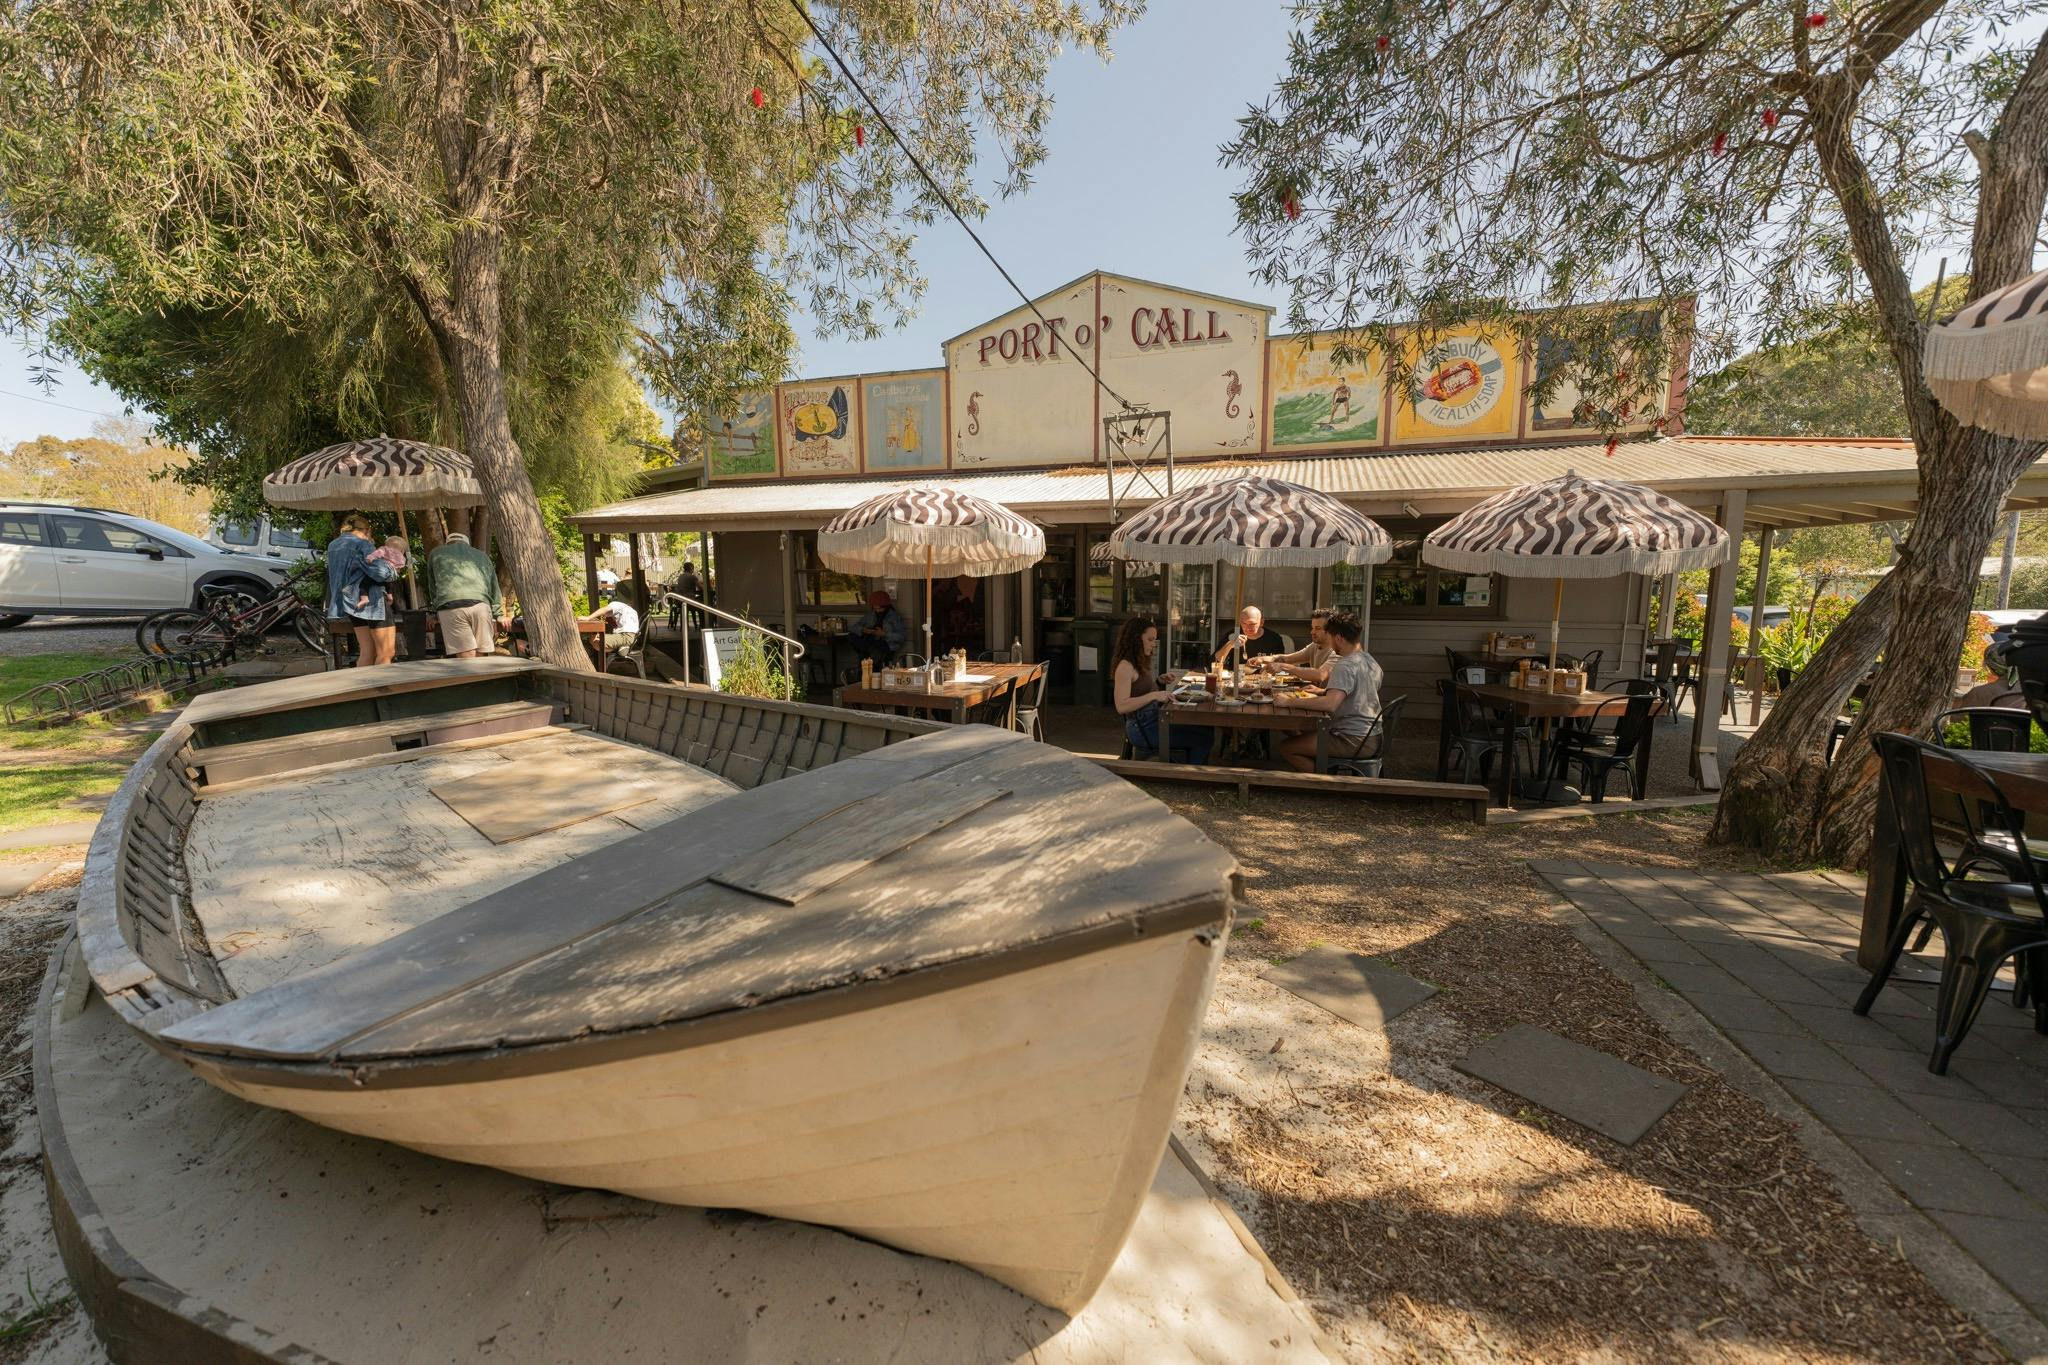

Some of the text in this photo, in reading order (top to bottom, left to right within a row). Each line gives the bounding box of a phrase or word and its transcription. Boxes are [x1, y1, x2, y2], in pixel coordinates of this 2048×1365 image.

[978, 316, 1066, 364] PORT
[1131, 306, 1229, 349] CALL
[1429, 401, 1482, 420] HEALTH
[1477, 374, 1498, 405] SOAP
[714, 637, 726, 645] Art
